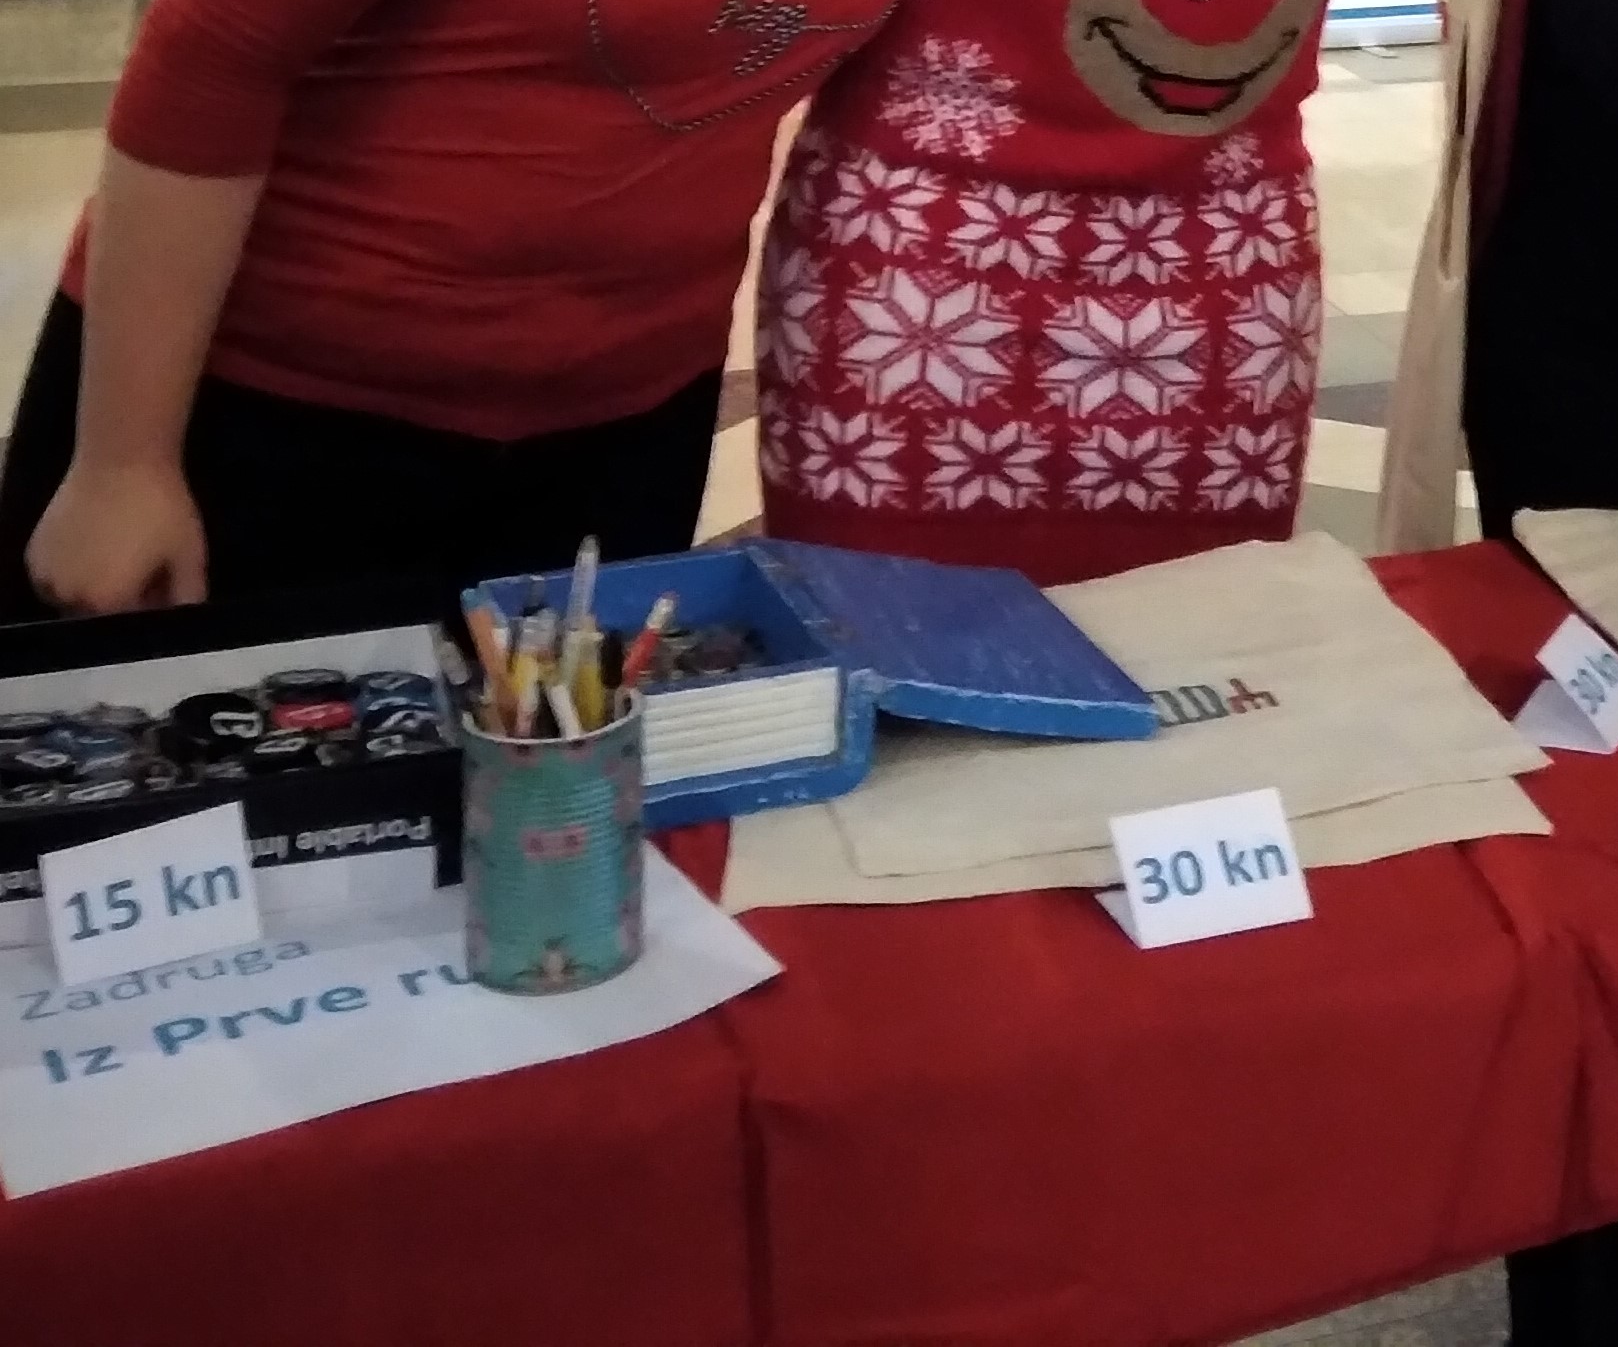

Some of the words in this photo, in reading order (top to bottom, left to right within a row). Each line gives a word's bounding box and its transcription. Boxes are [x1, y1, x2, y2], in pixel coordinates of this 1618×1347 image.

[64, 879, 142, 941] 15
[161, 863, 241, 916] kn
[1133, 849, 1204, 906] 30
[1217, 839, 1289, 887] kn
[18, 939, 313, 1021] Zadruga
[41, 1043, 124, 1084] Iz
[151, 984, 370, 1056] Prve
